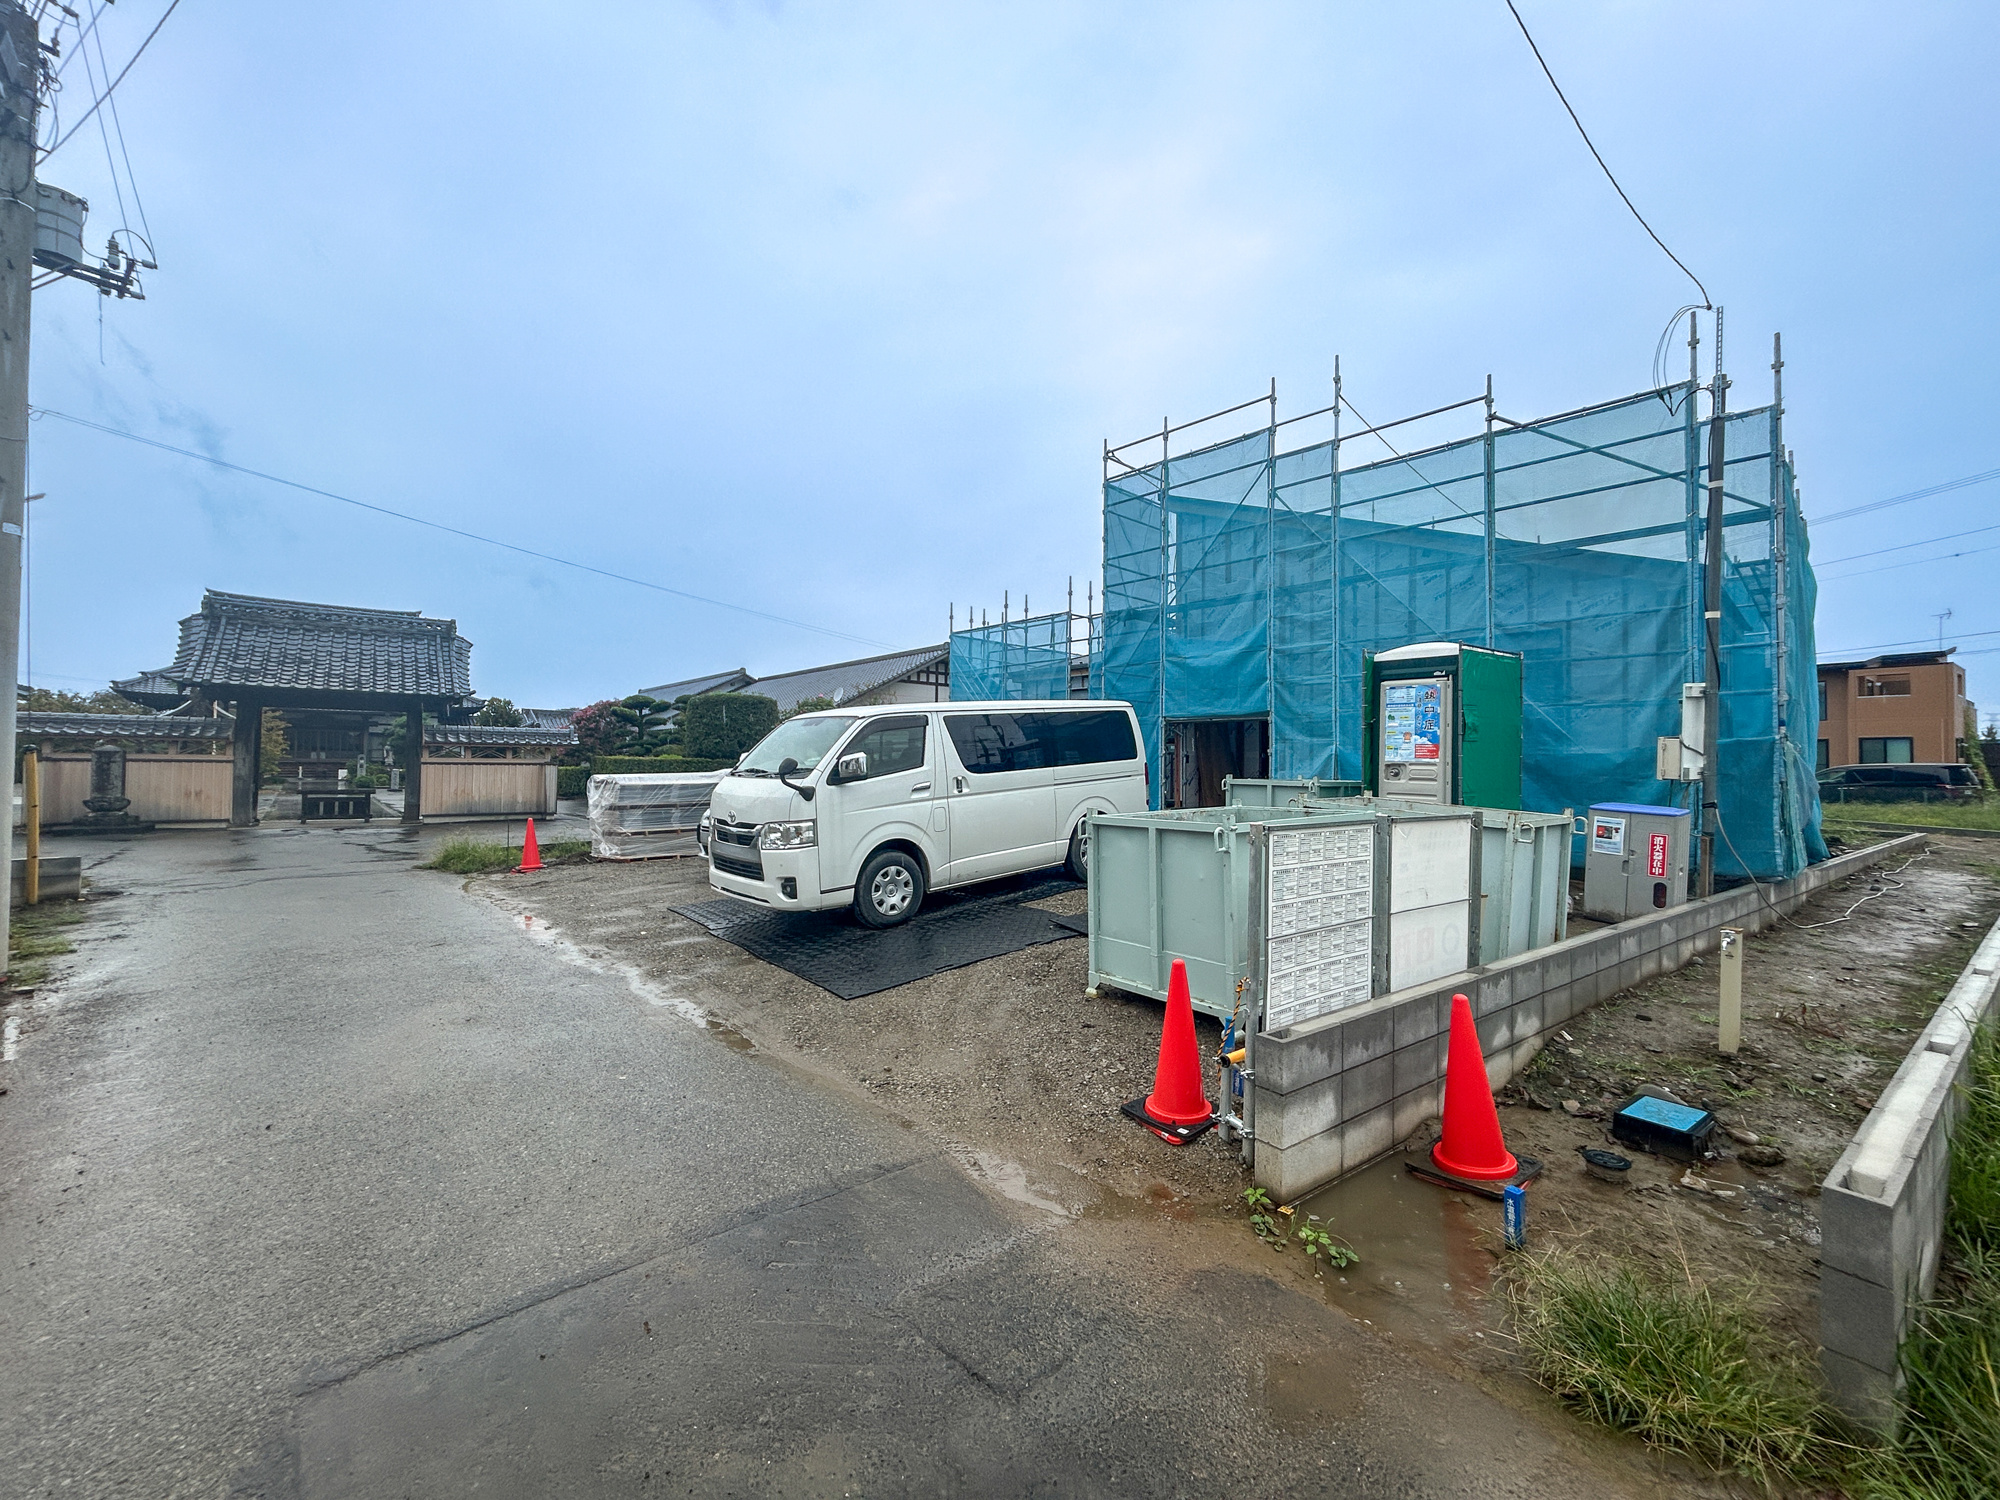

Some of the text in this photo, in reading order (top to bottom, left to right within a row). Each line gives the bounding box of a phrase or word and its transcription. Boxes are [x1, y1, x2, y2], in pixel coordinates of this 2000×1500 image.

[1652, 836, 1663, 875] 消火器在中
